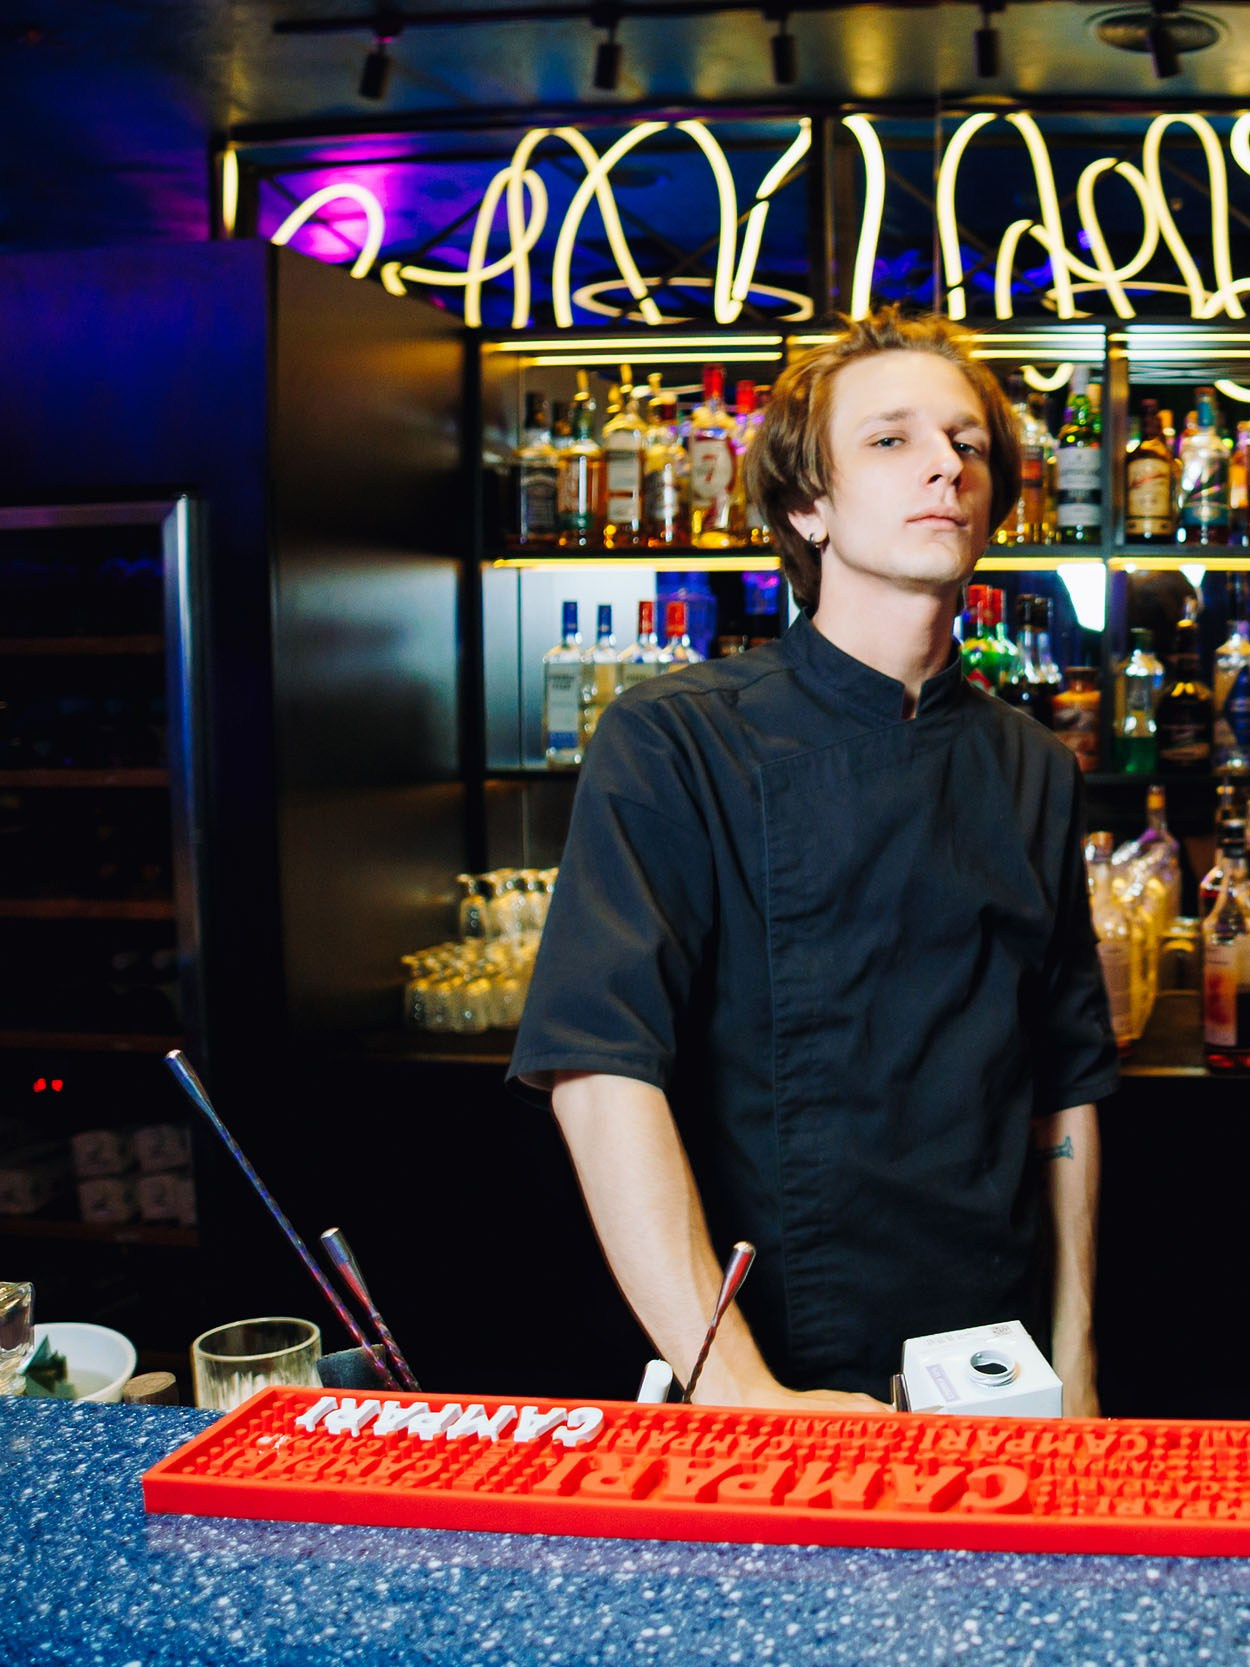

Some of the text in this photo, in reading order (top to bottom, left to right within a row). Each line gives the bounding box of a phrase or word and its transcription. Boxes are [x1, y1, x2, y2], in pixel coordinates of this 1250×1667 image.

[296, 1397, 604, 1448] CAMPARI
[785, 1418, 899, 1434] CAMPARI
[597, 1428, 795, 1455] CAMPARI
[918, 1428, 1149, 1456] CAMPARI
[210, 1445, 443, 1484] CAMPARI
[532, 1451, 1030, 1510] CAMPARI
